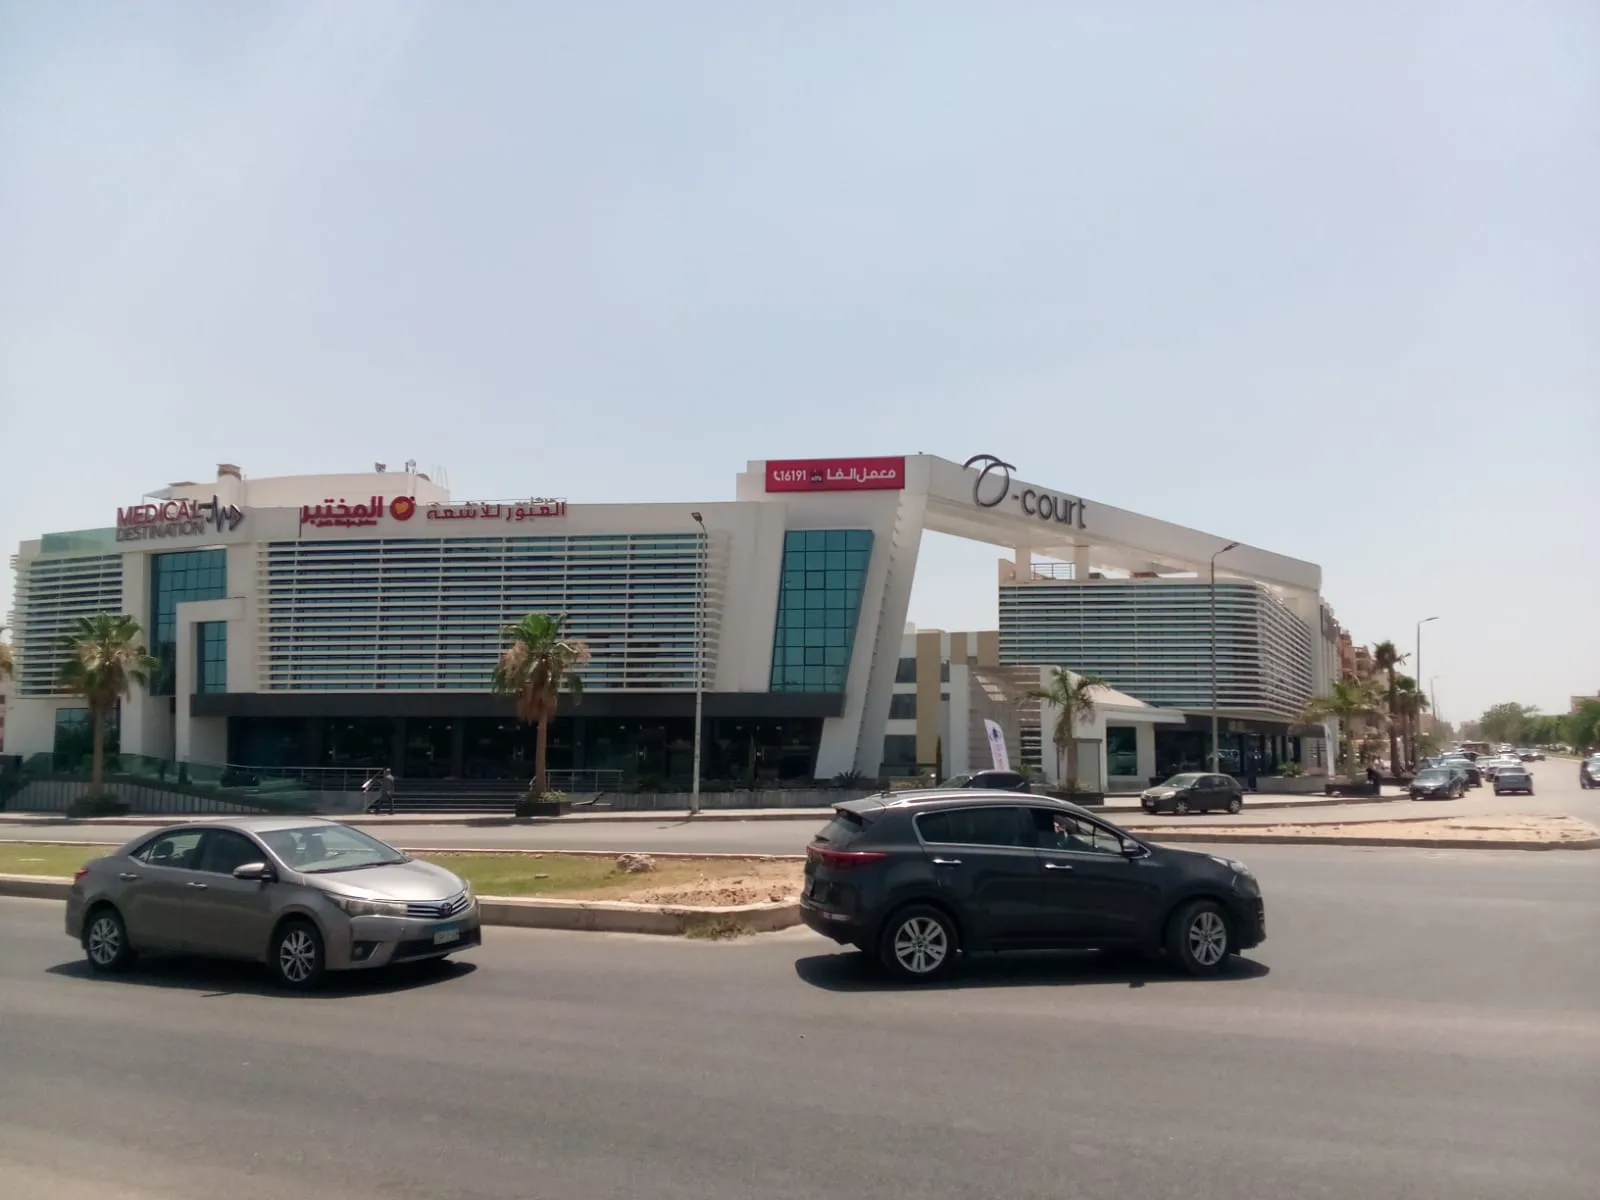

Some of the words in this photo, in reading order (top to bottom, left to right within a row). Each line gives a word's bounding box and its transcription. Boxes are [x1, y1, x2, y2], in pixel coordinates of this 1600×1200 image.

[780, 469, 807, 481] 16191
[856, 467, 897, 482] معمل
[116, 499, 204, 527] MEDICAL
[302, 495, 384, 524] المختبر
[116, 520, 205, 542] DESTINATION
